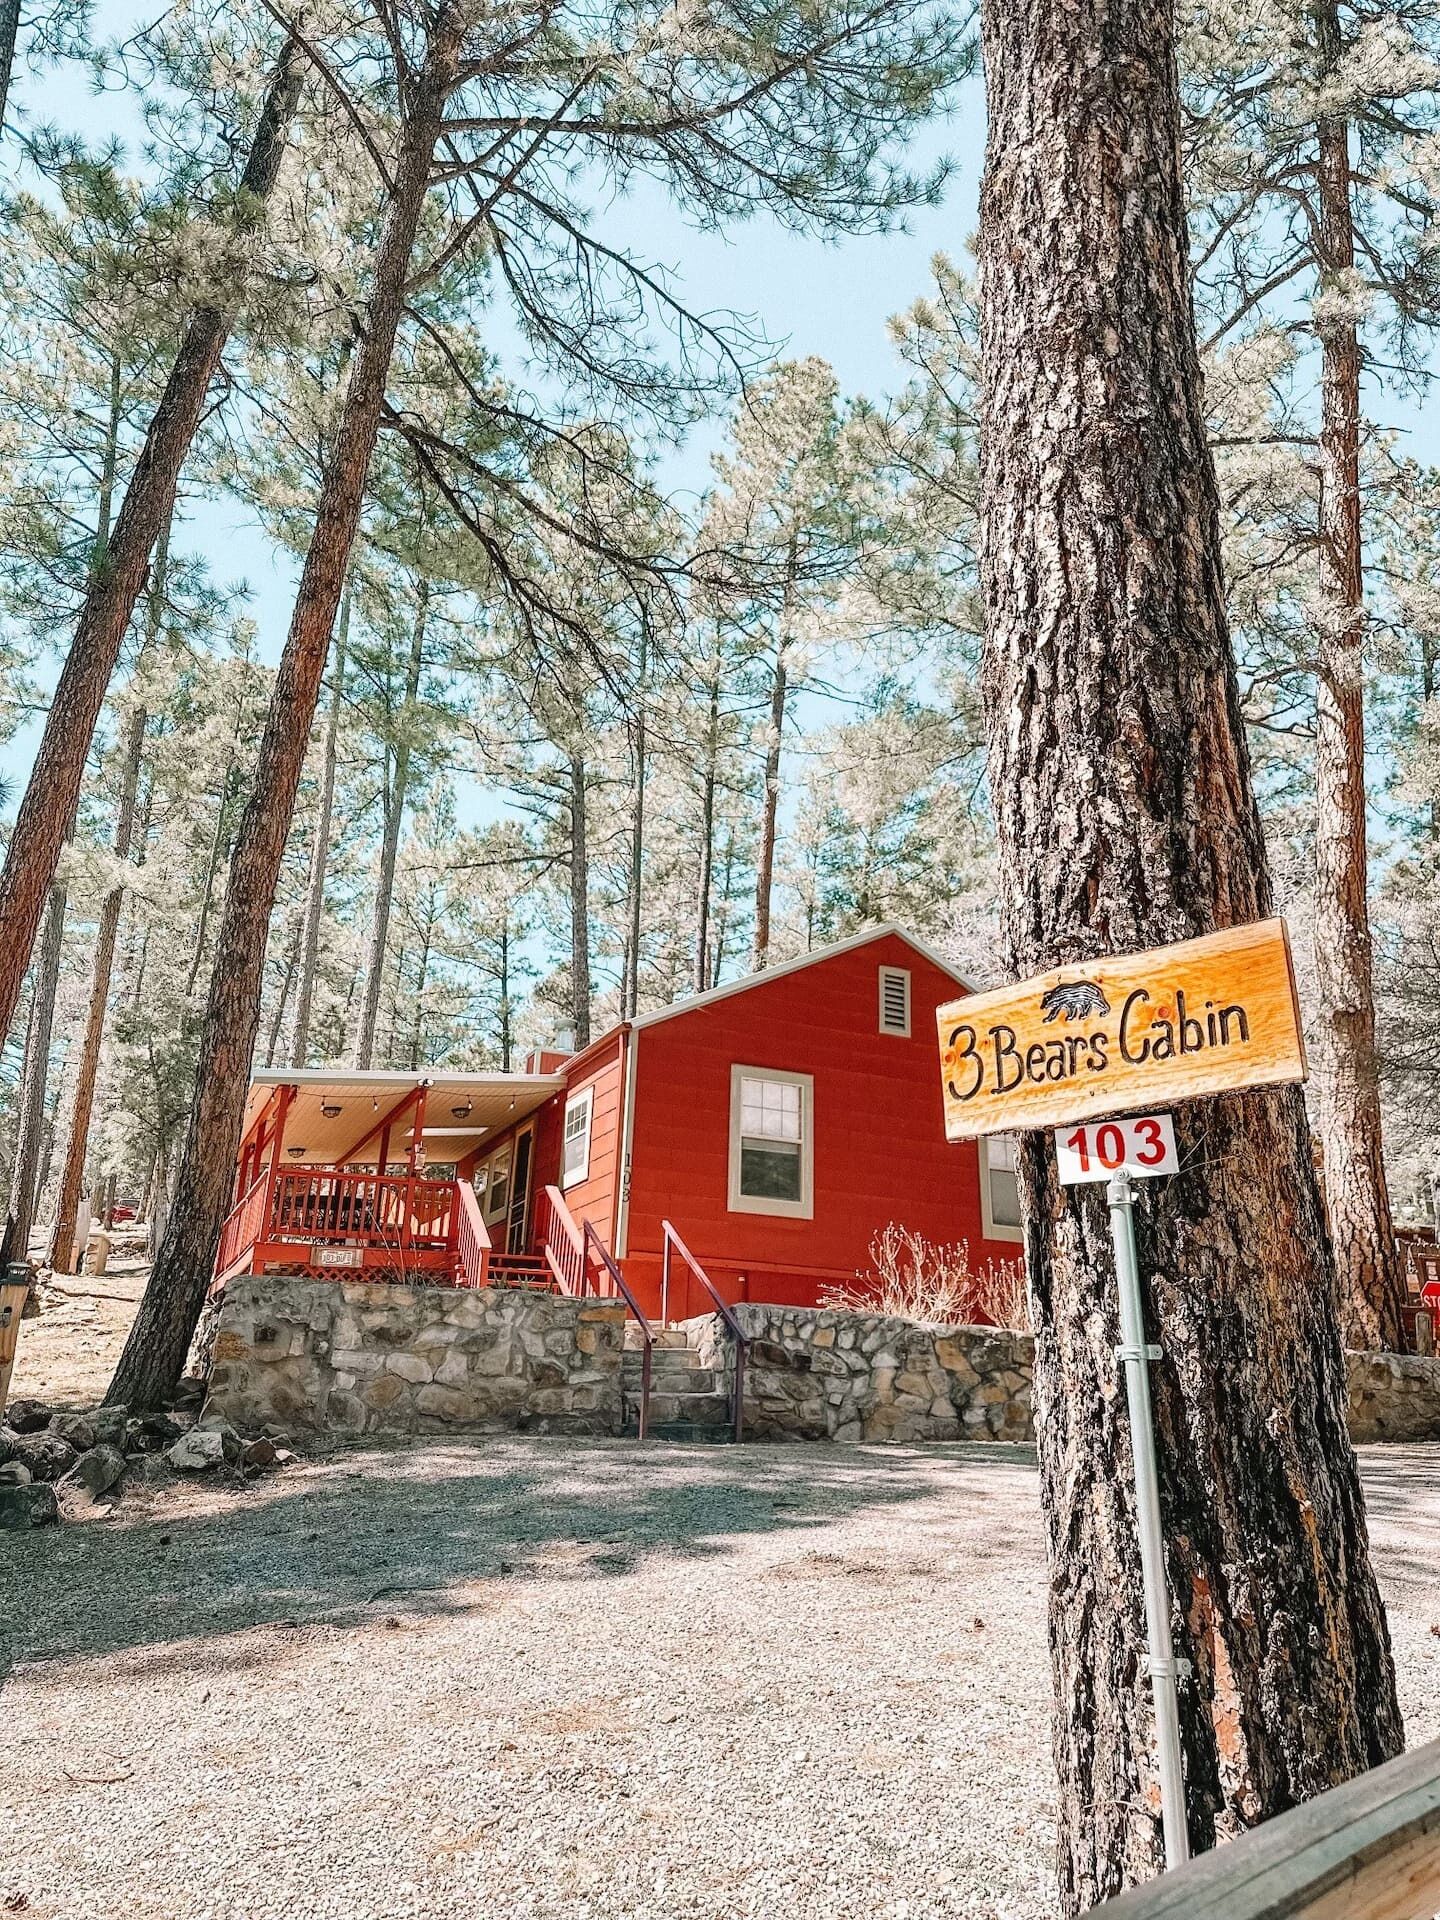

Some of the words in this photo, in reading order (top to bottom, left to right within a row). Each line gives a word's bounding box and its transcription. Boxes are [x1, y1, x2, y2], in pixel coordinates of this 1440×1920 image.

[949, 1025, 984, 1101] 3
[988, 1025, 1109, 1094] Bears
[1119, 988, 1250, 1064] Cabin
[1067, 1119, 1166, 1172] 103
[623, 1153, 631, 1202] 103
